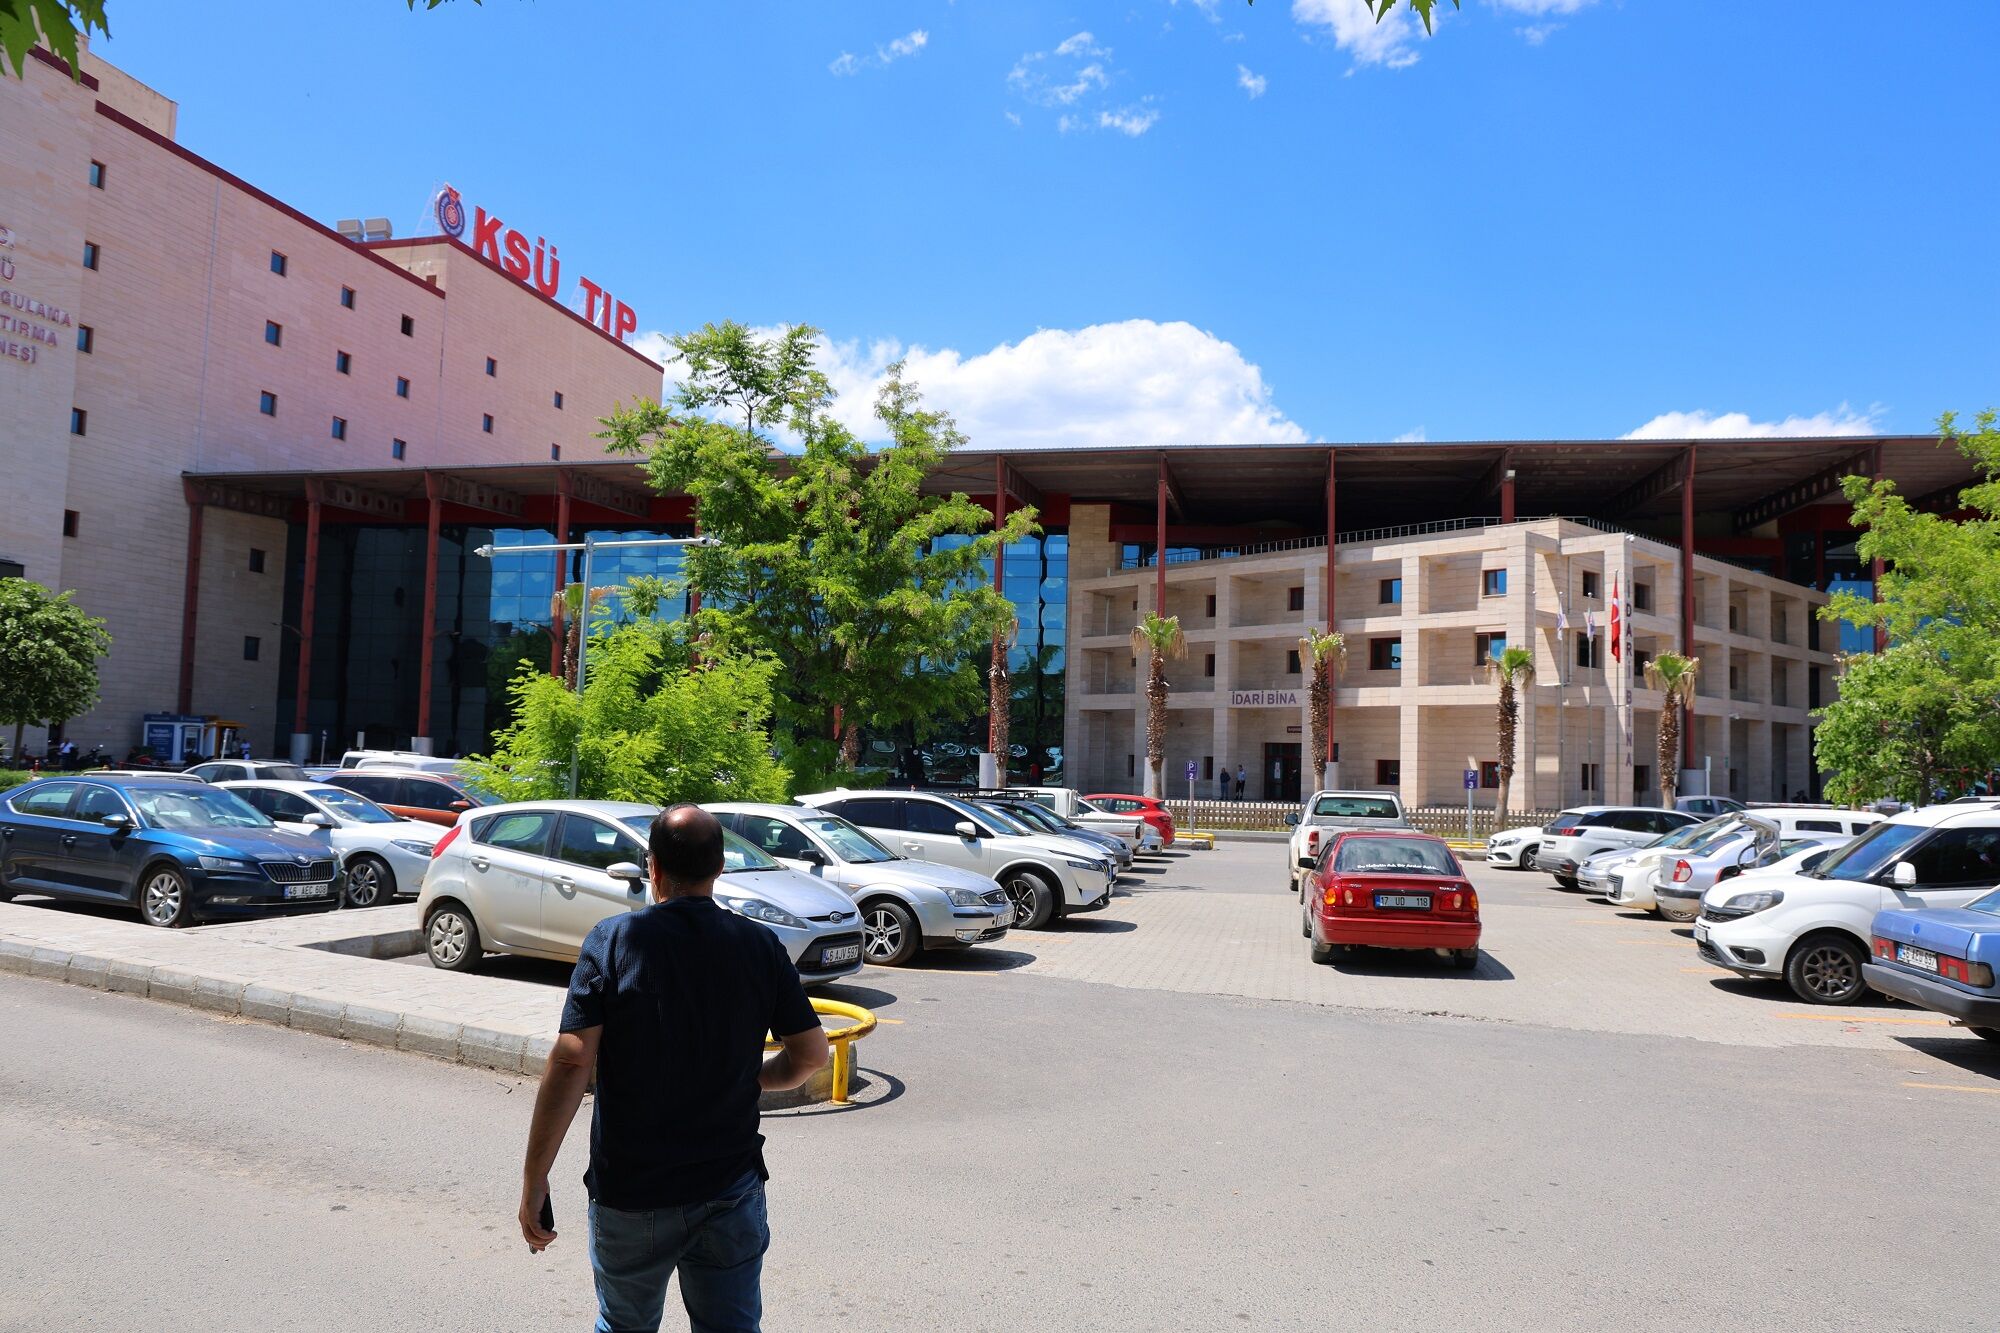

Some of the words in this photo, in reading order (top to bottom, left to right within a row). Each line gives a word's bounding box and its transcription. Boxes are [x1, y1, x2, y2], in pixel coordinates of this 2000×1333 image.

[473, 206, 560, 299] KSÜ
[580, 276, 637, 342] TIP
[1232, 690, 1264, 705] İDARİ
[1267, 690, 1297, 705] BİNA
[1188, 762, 1195, 771] P
[1189, 772, 1194, 780] 2
[1468, 771, 1474, 779] P
[1468, 781, 1474, 789] 3
[1381, 896, 1389, 906] 17
